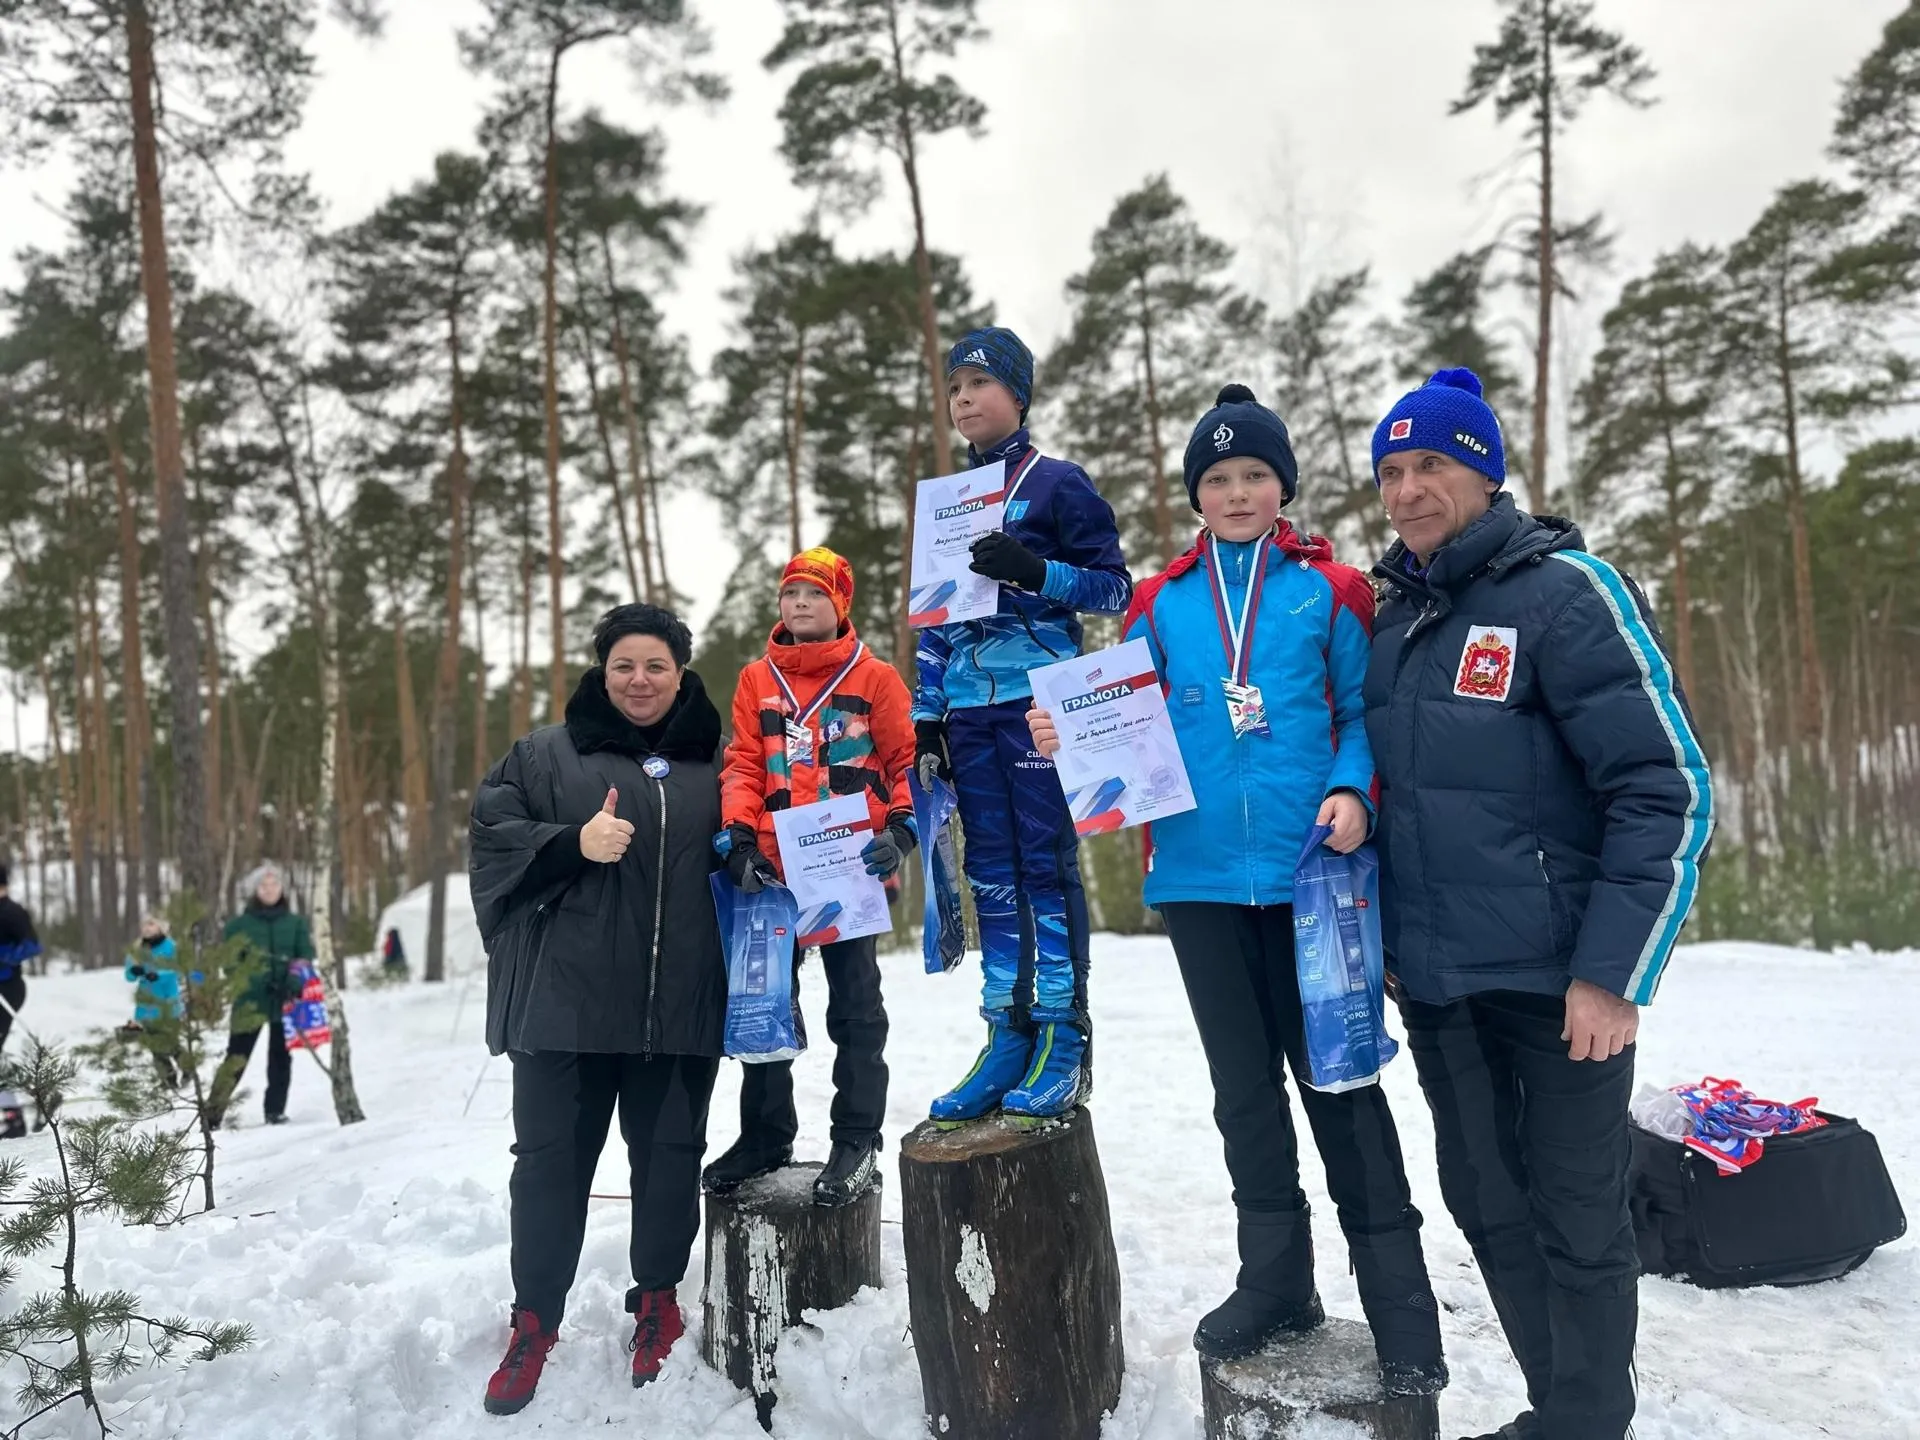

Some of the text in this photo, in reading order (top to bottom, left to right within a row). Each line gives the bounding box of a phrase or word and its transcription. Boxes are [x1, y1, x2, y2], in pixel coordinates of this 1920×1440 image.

[963, 356, 990, 367] adidas
[936, 500, 984, 519] ГРАМОТА
[1063, 684, 1132, 712] ГРАМОТА
[1102, 712, 1121, 721] место
[1233, 704, 1242, 717] 3
[789, 740, 796, 749] 2
[800, 827, 852, 846] ГРАМОТА
[1030, 1064, 1081, 1110] SPINE
